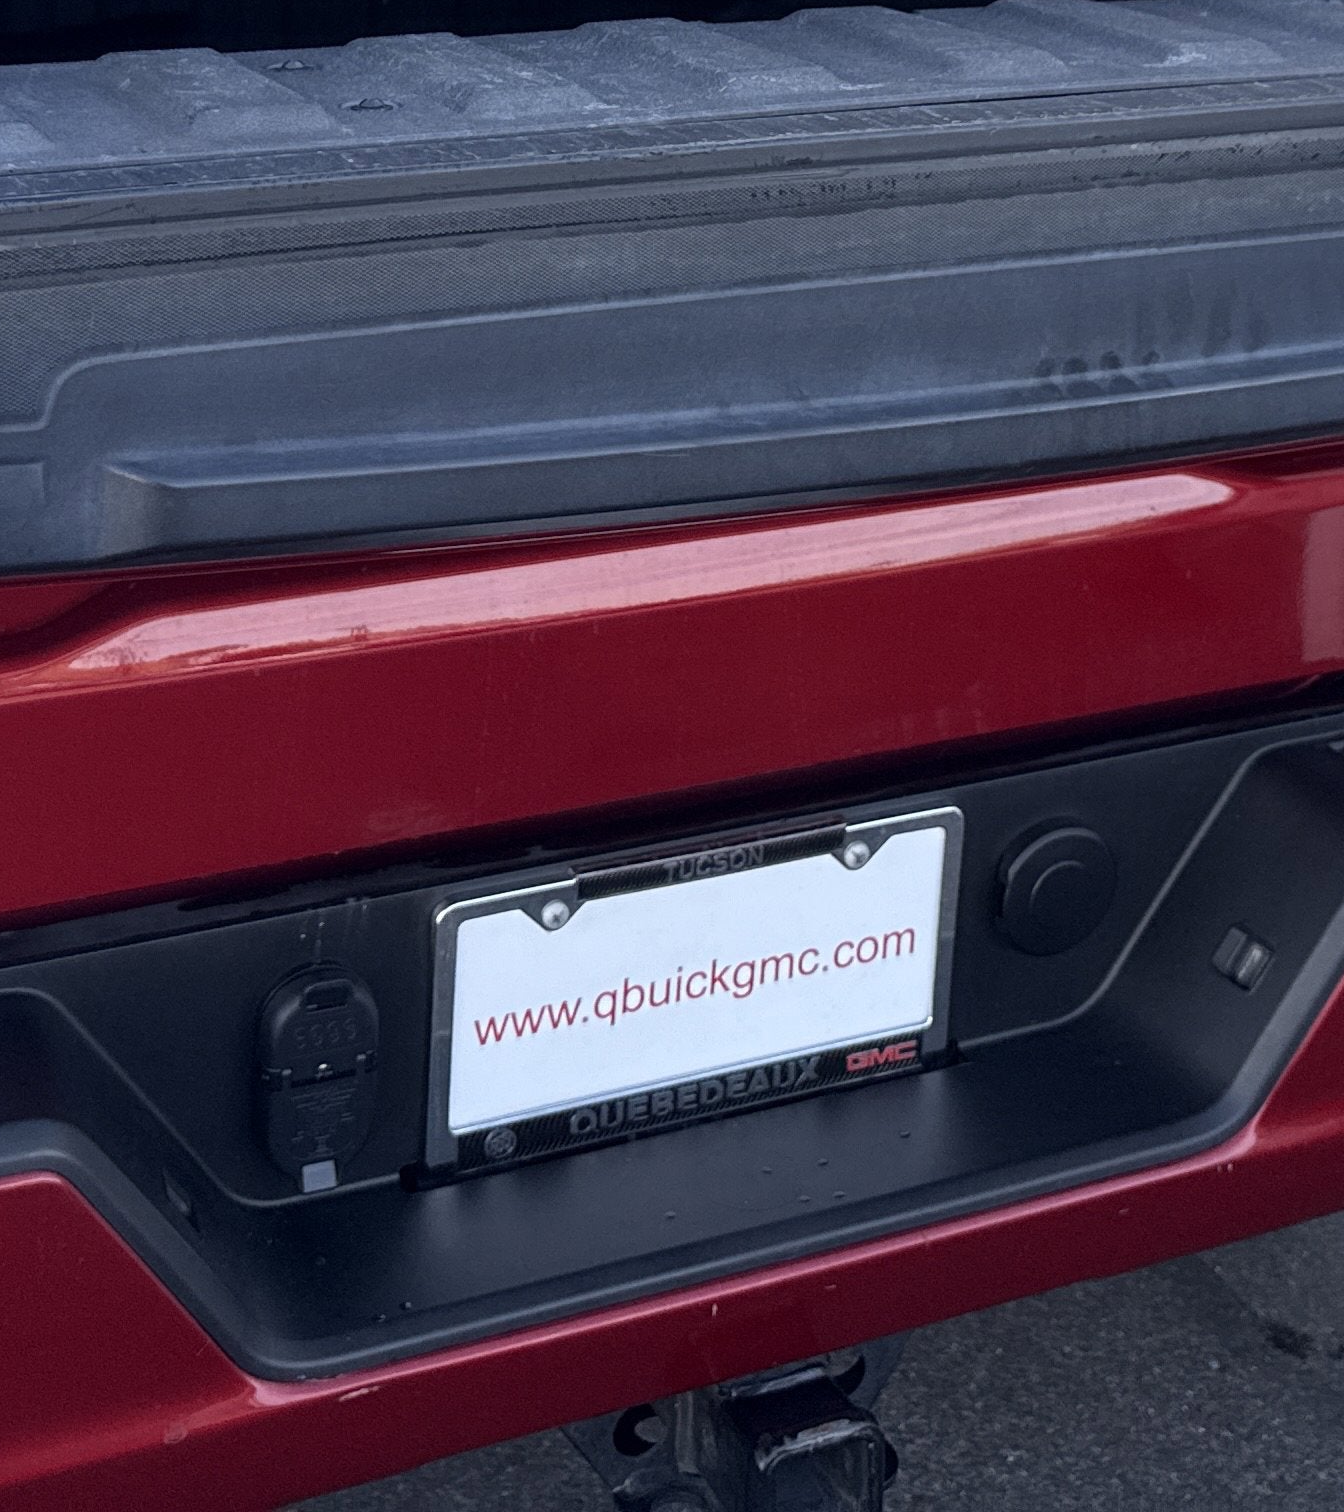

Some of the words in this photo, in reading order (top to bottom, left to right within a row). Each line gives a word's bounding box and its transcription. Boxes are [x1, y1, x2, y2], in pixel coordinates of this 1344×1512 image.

[663, 845, 765, 884] TUCSON
[473, 926, 916, 1046] www.qbuickgmc.com
[568, 1054, 822, 1137] QUEBEDEAUX
[845, 1040, 918, 1074] GMC
